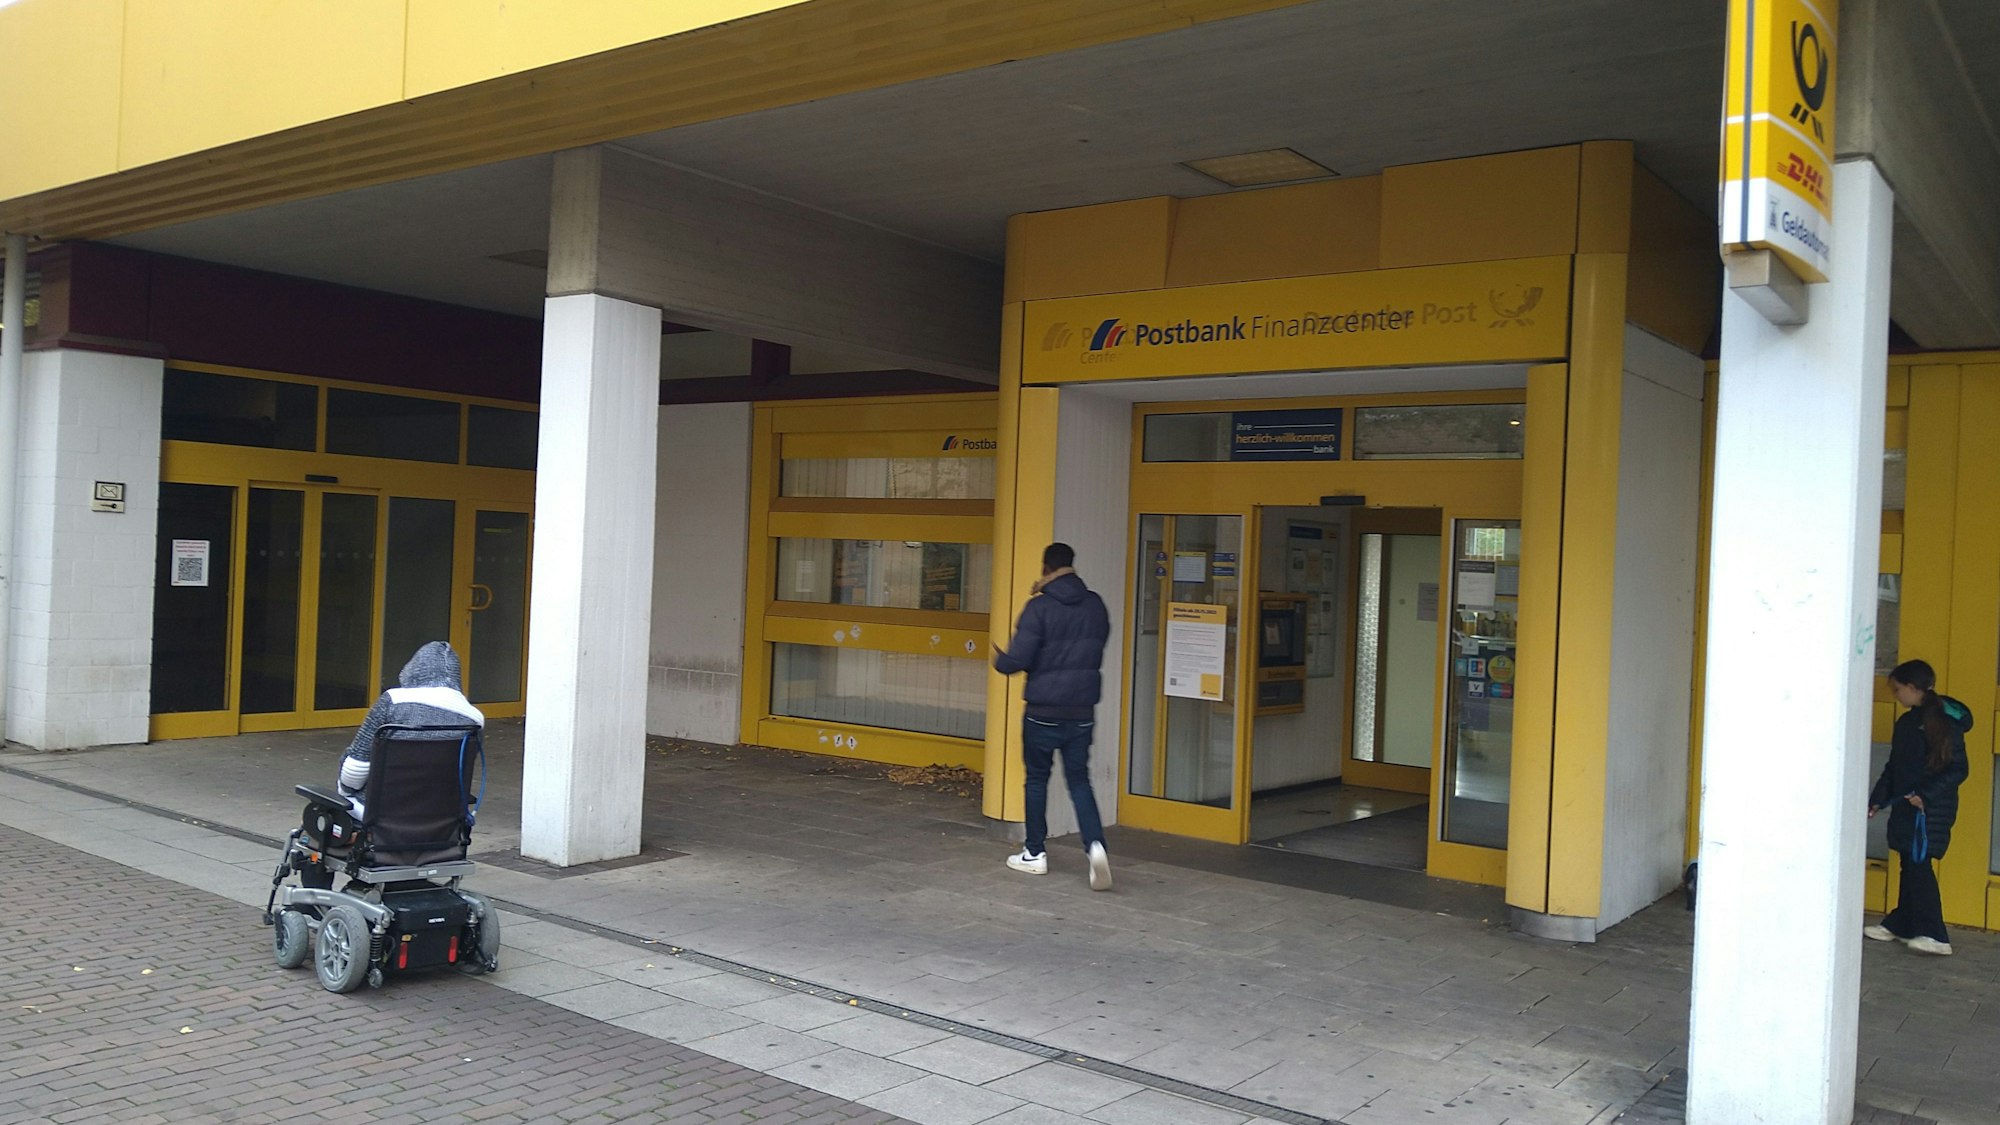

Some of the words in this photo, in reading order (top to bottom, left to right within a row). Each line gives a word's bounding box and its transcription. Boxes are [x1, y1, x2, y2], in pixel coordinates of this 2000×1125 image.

[1786, 152, 1828, 206] DHL
[1423, 302, 1477, 324] Post
[1135, 315, 1246, 346] Postbank
[1251, 309, 1414, 339] Finanzcenter
[962, 438, 997, 450] Postba
[1235, 433, 1335, 443] herzlich-willkommen
[1313, 445, 1335, 453] bank
